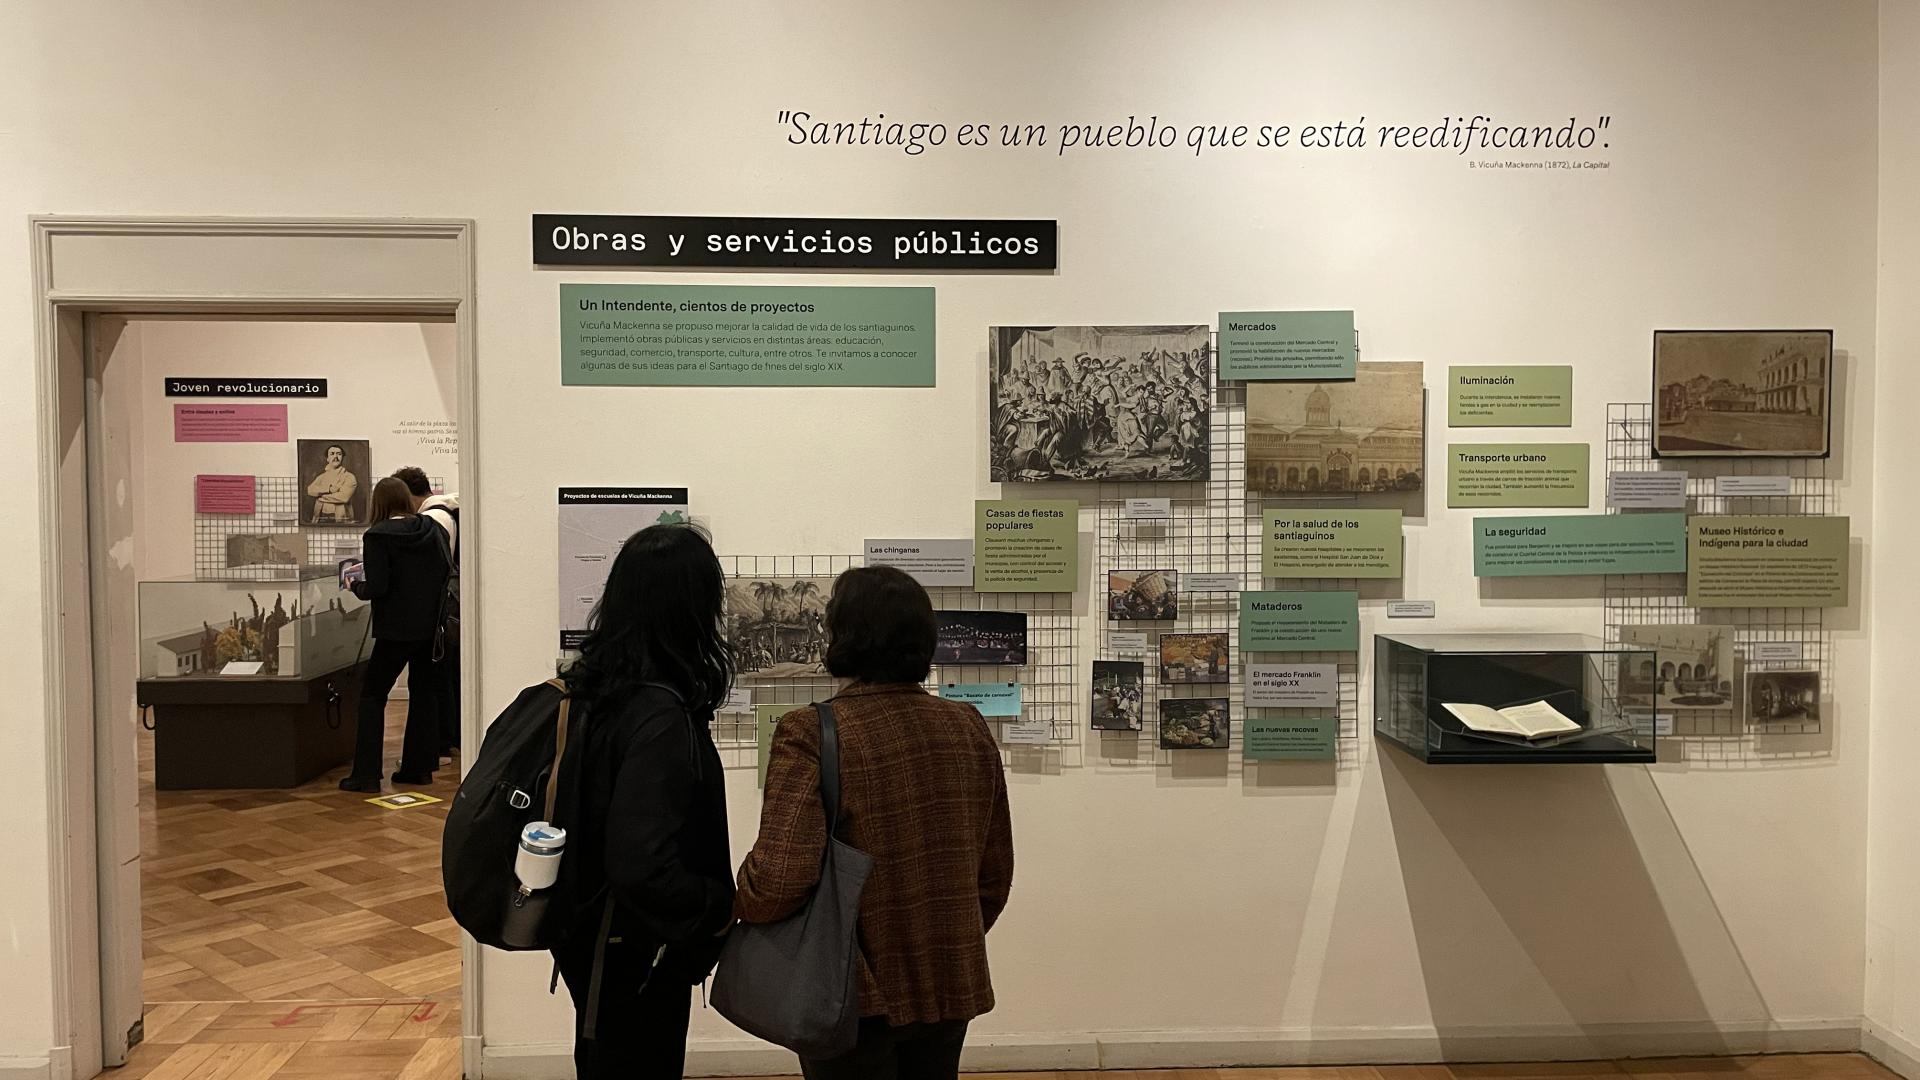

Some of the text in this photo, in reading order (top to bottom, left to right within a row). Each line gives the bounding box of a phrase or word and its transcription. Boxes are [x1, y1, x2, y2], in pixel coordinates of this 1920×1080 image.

[779, 111, 1610, 156] "Santiago es un pueblo que se está reedificando".
[1479, 160, 1503, 168] Vicuña
[1505, 160, 1543, 168] Mackenna
[1573, 160, 1582, 168] La
[1584, 160, 1610, 171] Capital
[552, 226, 1039, 261] Obras y servicios públicos
[580, 300, 814, 315] Un Intendente, cientos de proyectos
[580, 321, 611, 329] Vicuña
[614, 321, 660, 330] Mackenna
[676, 324, 713, 332] propuso
[716, 322, 749, 333] mejorar
[752, 322, 760, 331] la
[762, 322, 794, 331] calidad
[796, 322, 808, 331] de
[810, 323, 828, 331] vida
[830, 323, 841, 331] de
[844, 323, 857, 331] los
[859, 323, 915, 334] santiaguinos.
[1229, 323, 1276, 331] Mercados
[580, 334, 634, 345] Implementó
[637, 335, 662, 343] obras
[665, 335, 703, 346] públicas
[712, 335, 752, 344] servicios
[767, 335, 804, 344] distintas
[836, 336, 884, 346] educación,
[580, 348, 628, 358] seguridad,
[630, 348, 675, 358] comercio,
[677, 349, 726, 359] transporte,
[728, 349, 762, 358] cultura,
[817, 349, 827, 357] Te
[829, 349, 871, 357] invitamos
[581, 361, 616, 371] algunas
[618, 361, 630, 369] de
[650, 361, 674, 370] ideas
[677, 364, 697, 372] para
[699, 362, 707, 370] el
[710, 362, 750, 372] Santiago
[751, 362, 763, 370] de
[765, 362, 787, 370] fines
[789, 362, 803, 370] del
[805, 362, 826, 373] siglo
[828, 362, 844, 371] XIX.
[1461, 376, 1514, 384] Iluminación
[173, 383, 319, 393] Joven revolucionario
[1460, 454, 1510, 463] Transporte
[986, 509, 1064, 517] Casas de fiestas
[986, 521, 1033, 532] populares
[1275, 520, 1359, 528] Por la salud de los
[1485, 527, 1546, 538] La seguridad
[1700, 527, 1731, 535] Museo
[1734, 527, 1776, 535] Histórico
[1274, 531, 1334, 542] santiaguinos
[1700, 539, 1808, 549] Indígena para la ciudad
[884, 547, 920, 555] chinganas
[1252, 602, 1302, 610] Mataderos
[1271, 680, 1287, 688] siglo
